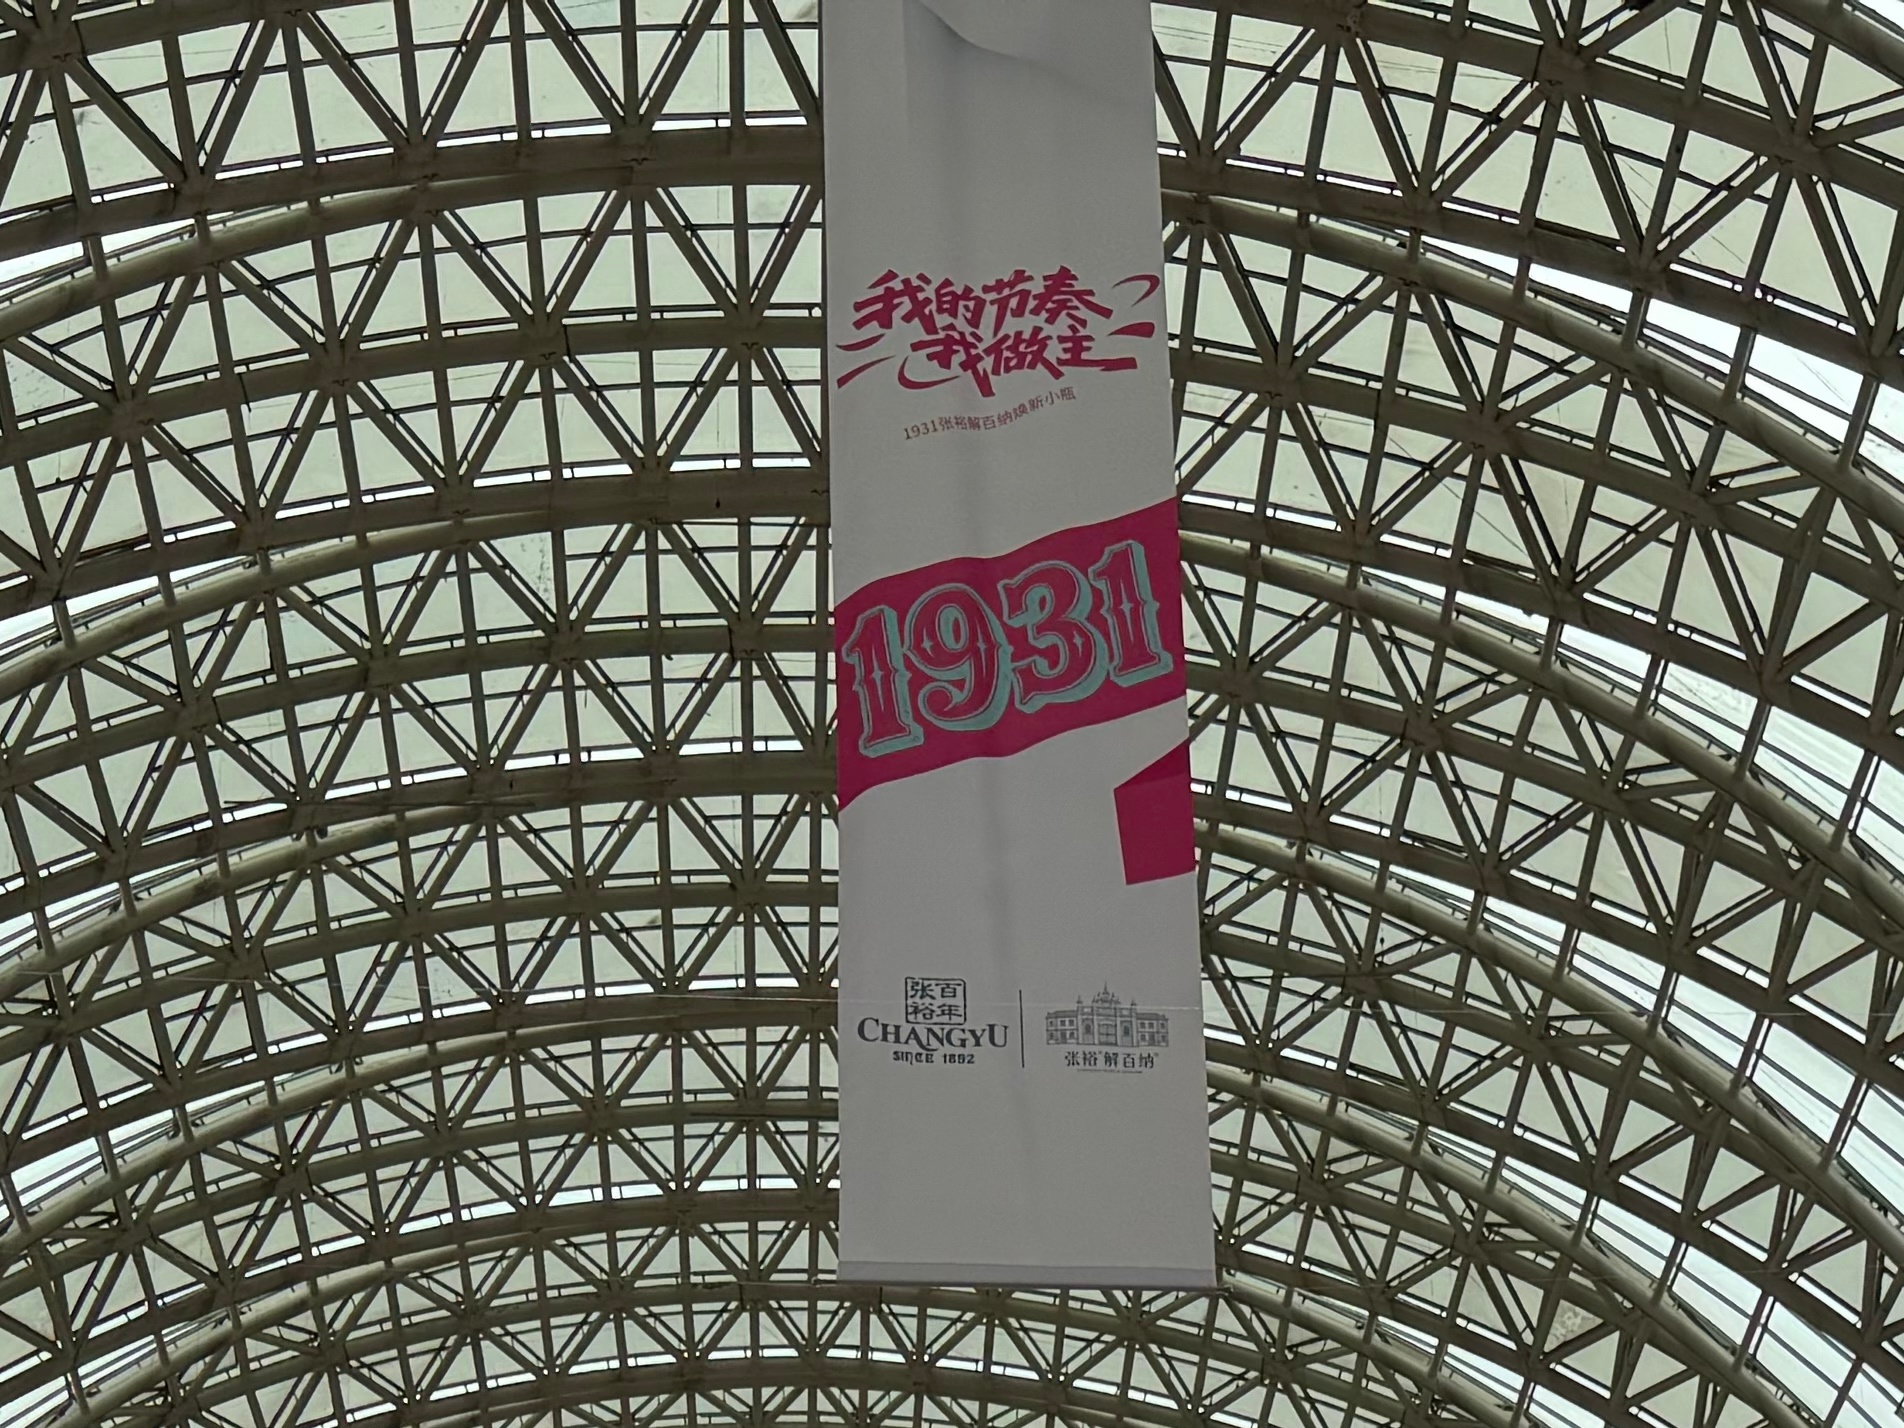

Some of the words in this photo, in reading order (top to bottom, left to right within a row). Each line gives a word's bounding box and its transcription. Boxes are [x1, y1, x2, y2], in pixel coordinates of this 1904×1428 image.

[853, 265, 1114, 338] 我的节奏
[909, 322, 1138, 399] 我做主
[843, 538, 1174, 764] 1931
[857, 1017, 1008, 1051] CHANGYU
